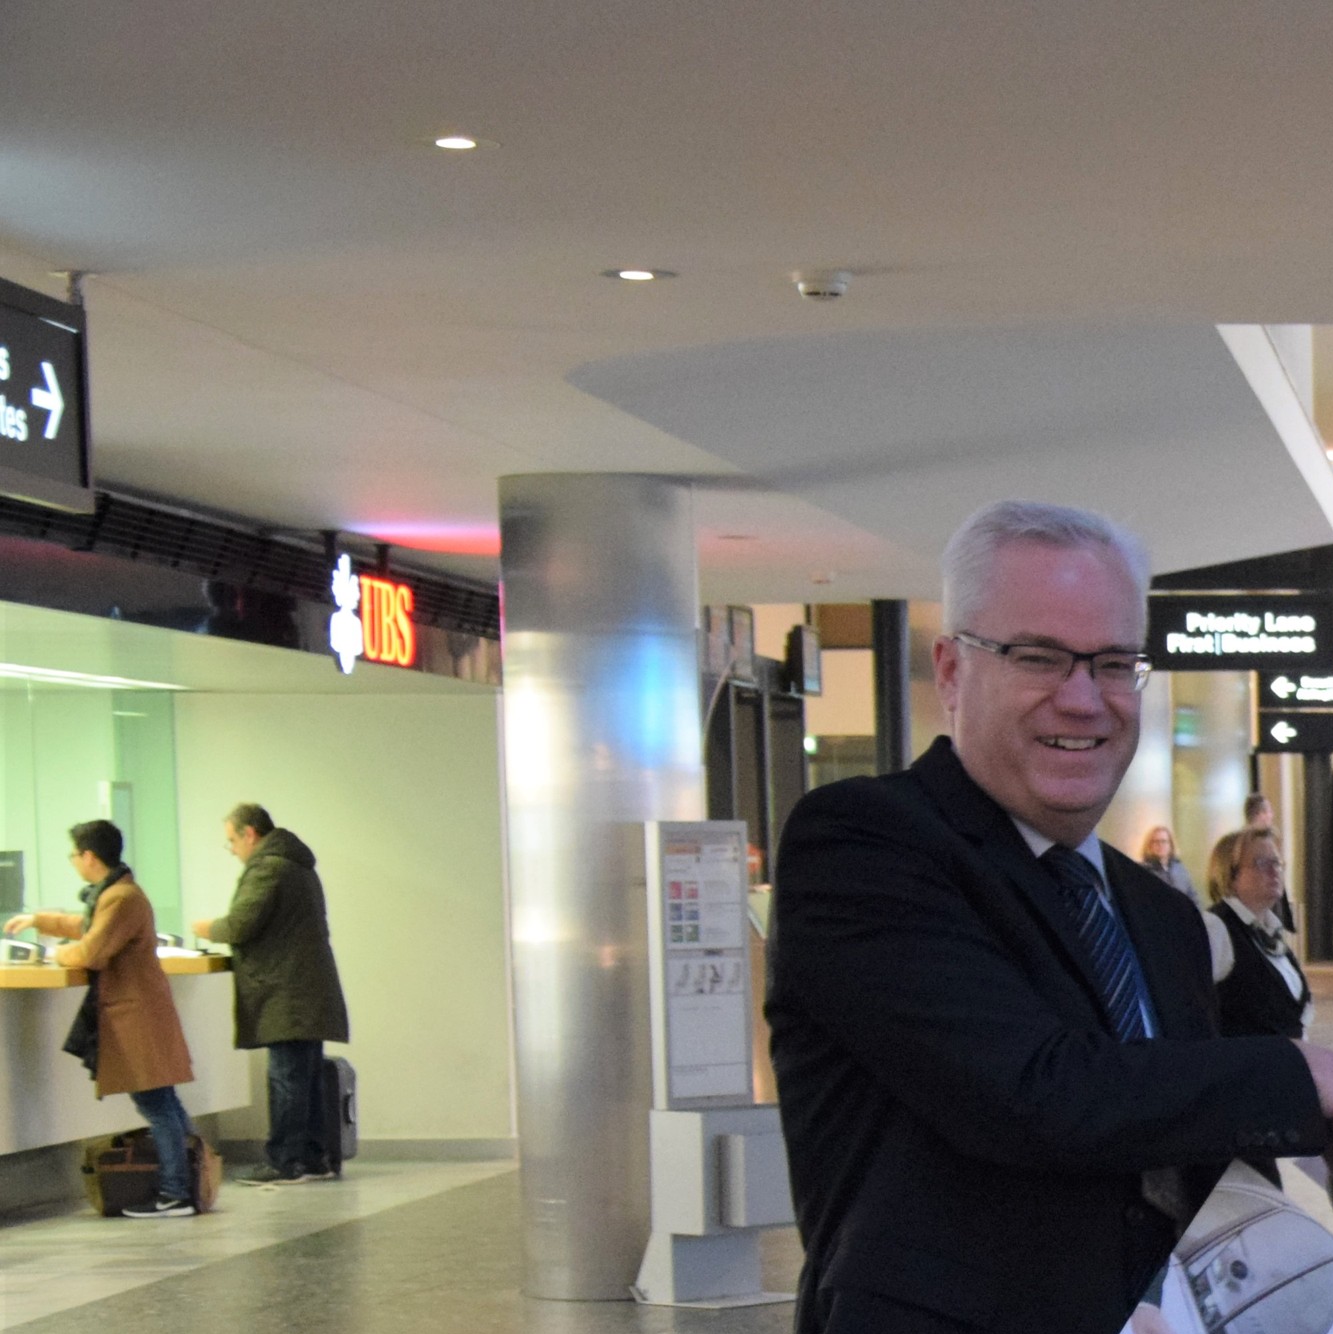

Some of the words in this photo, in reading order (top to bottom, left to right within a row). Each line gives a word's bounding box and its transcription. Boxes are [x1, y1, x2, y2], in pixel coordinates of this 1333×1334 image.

[359, 573, 416, 668] UBS
[1185, 612, 1261, 636] Priority
[1264, 611, 1316, 632] Lane
[1221, 633, 1317, 653] Business
